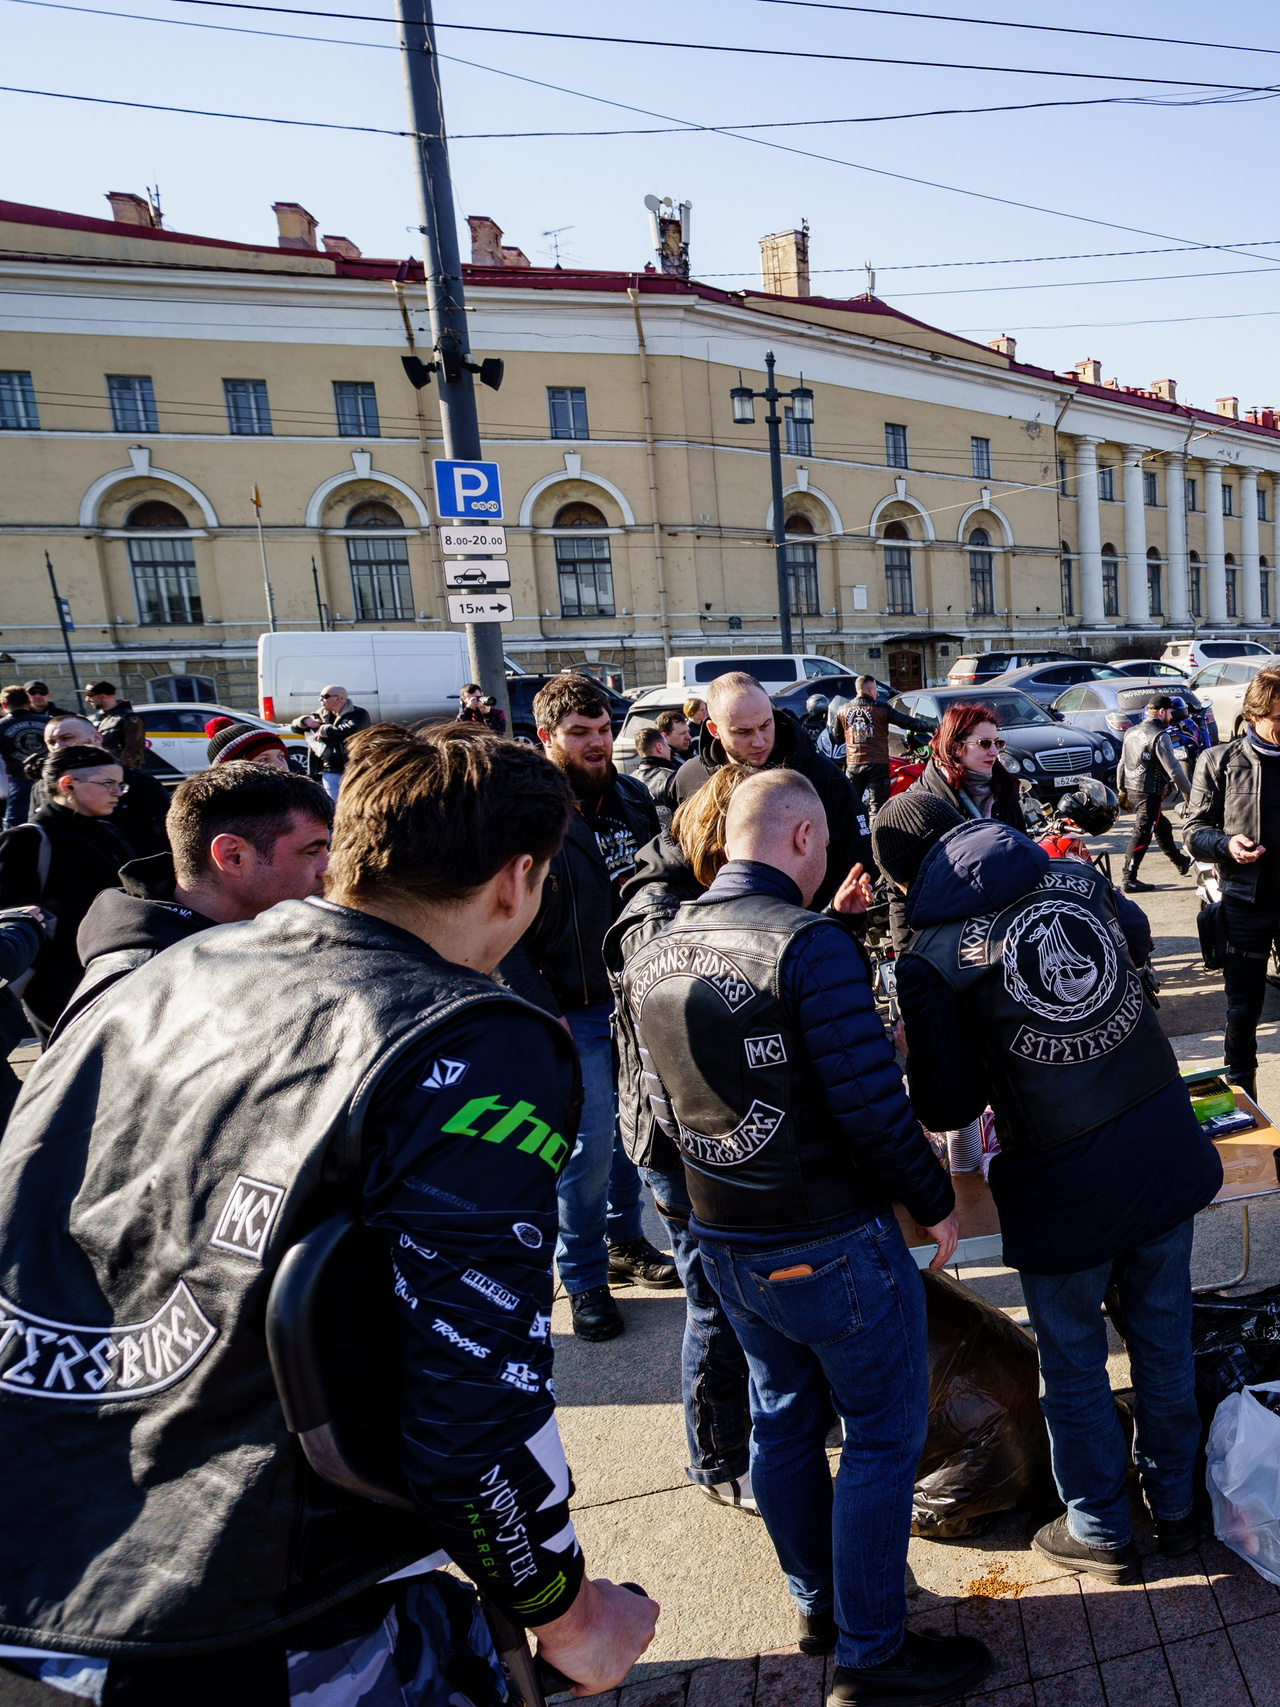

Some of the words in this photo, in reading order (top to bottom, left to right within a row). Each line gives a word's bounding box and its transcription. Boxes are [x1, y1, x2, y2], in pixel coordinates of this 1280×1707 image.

[453, 467, 488, 512] P
[480, 501, 486, 509] 15
[488, 502, 498, 510] 20
[445, 535, 503, 546] 8.00-20.00
[1123, 688, 1156, 699] NORMANS
[631, 948, 689, 1010] NORMANS
[691, 949, 747, 1003] RIDERS
[1020, 980, 1141, 1062] ST.PETERSBURG
[748, 1039, 782, 1065] MC
[219, 1185, 270, 1247] MC
[464, 1270, 519, 1307] HINSON
[0, 1304, 201, 1391] TERSBURG
[432, 1318, 491, 1359] TRAXXAS
[480, 1464, 537, 1587] MONSTER
